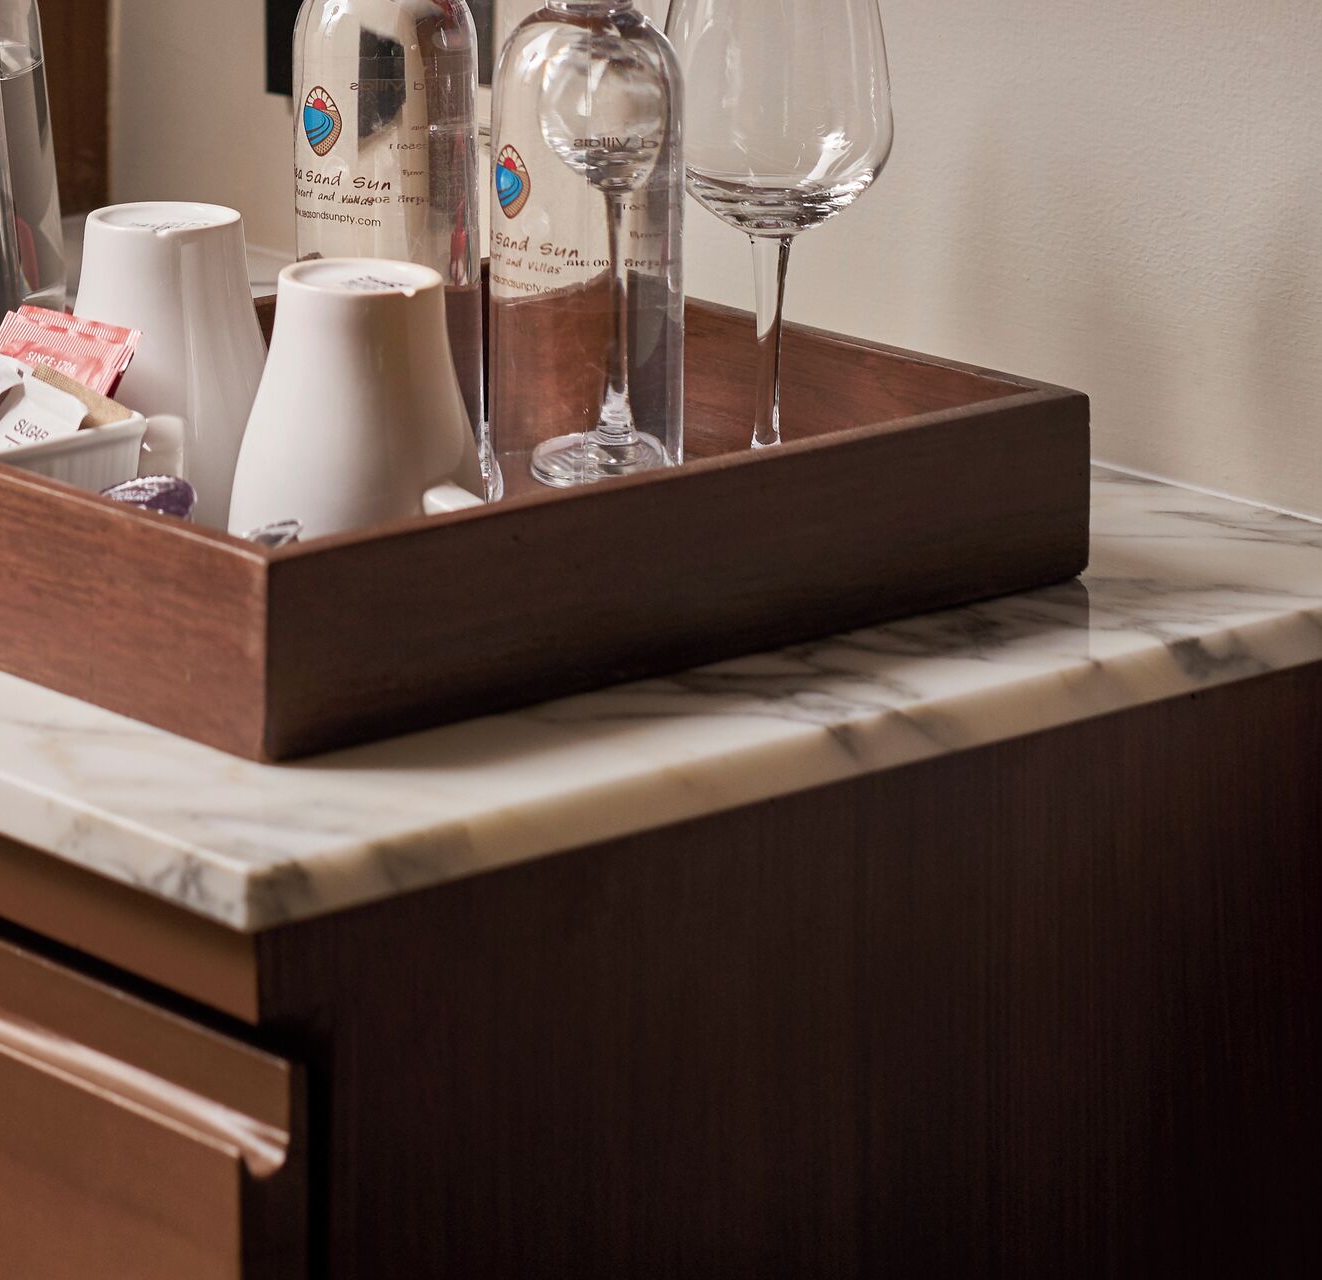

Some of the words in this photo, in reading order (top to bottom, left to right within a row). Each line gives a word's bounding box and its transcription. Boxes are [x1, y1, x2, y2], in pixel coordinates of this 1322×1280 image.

[305, 170, 342, 186] Sand
[353, 176, 391, 191] Sun
[318, 191, 336, 202] and
[496, 232, 530, 252] Sand
[540, 242, 579, 259] Sun
[528, 261, 562, 274] Villas
